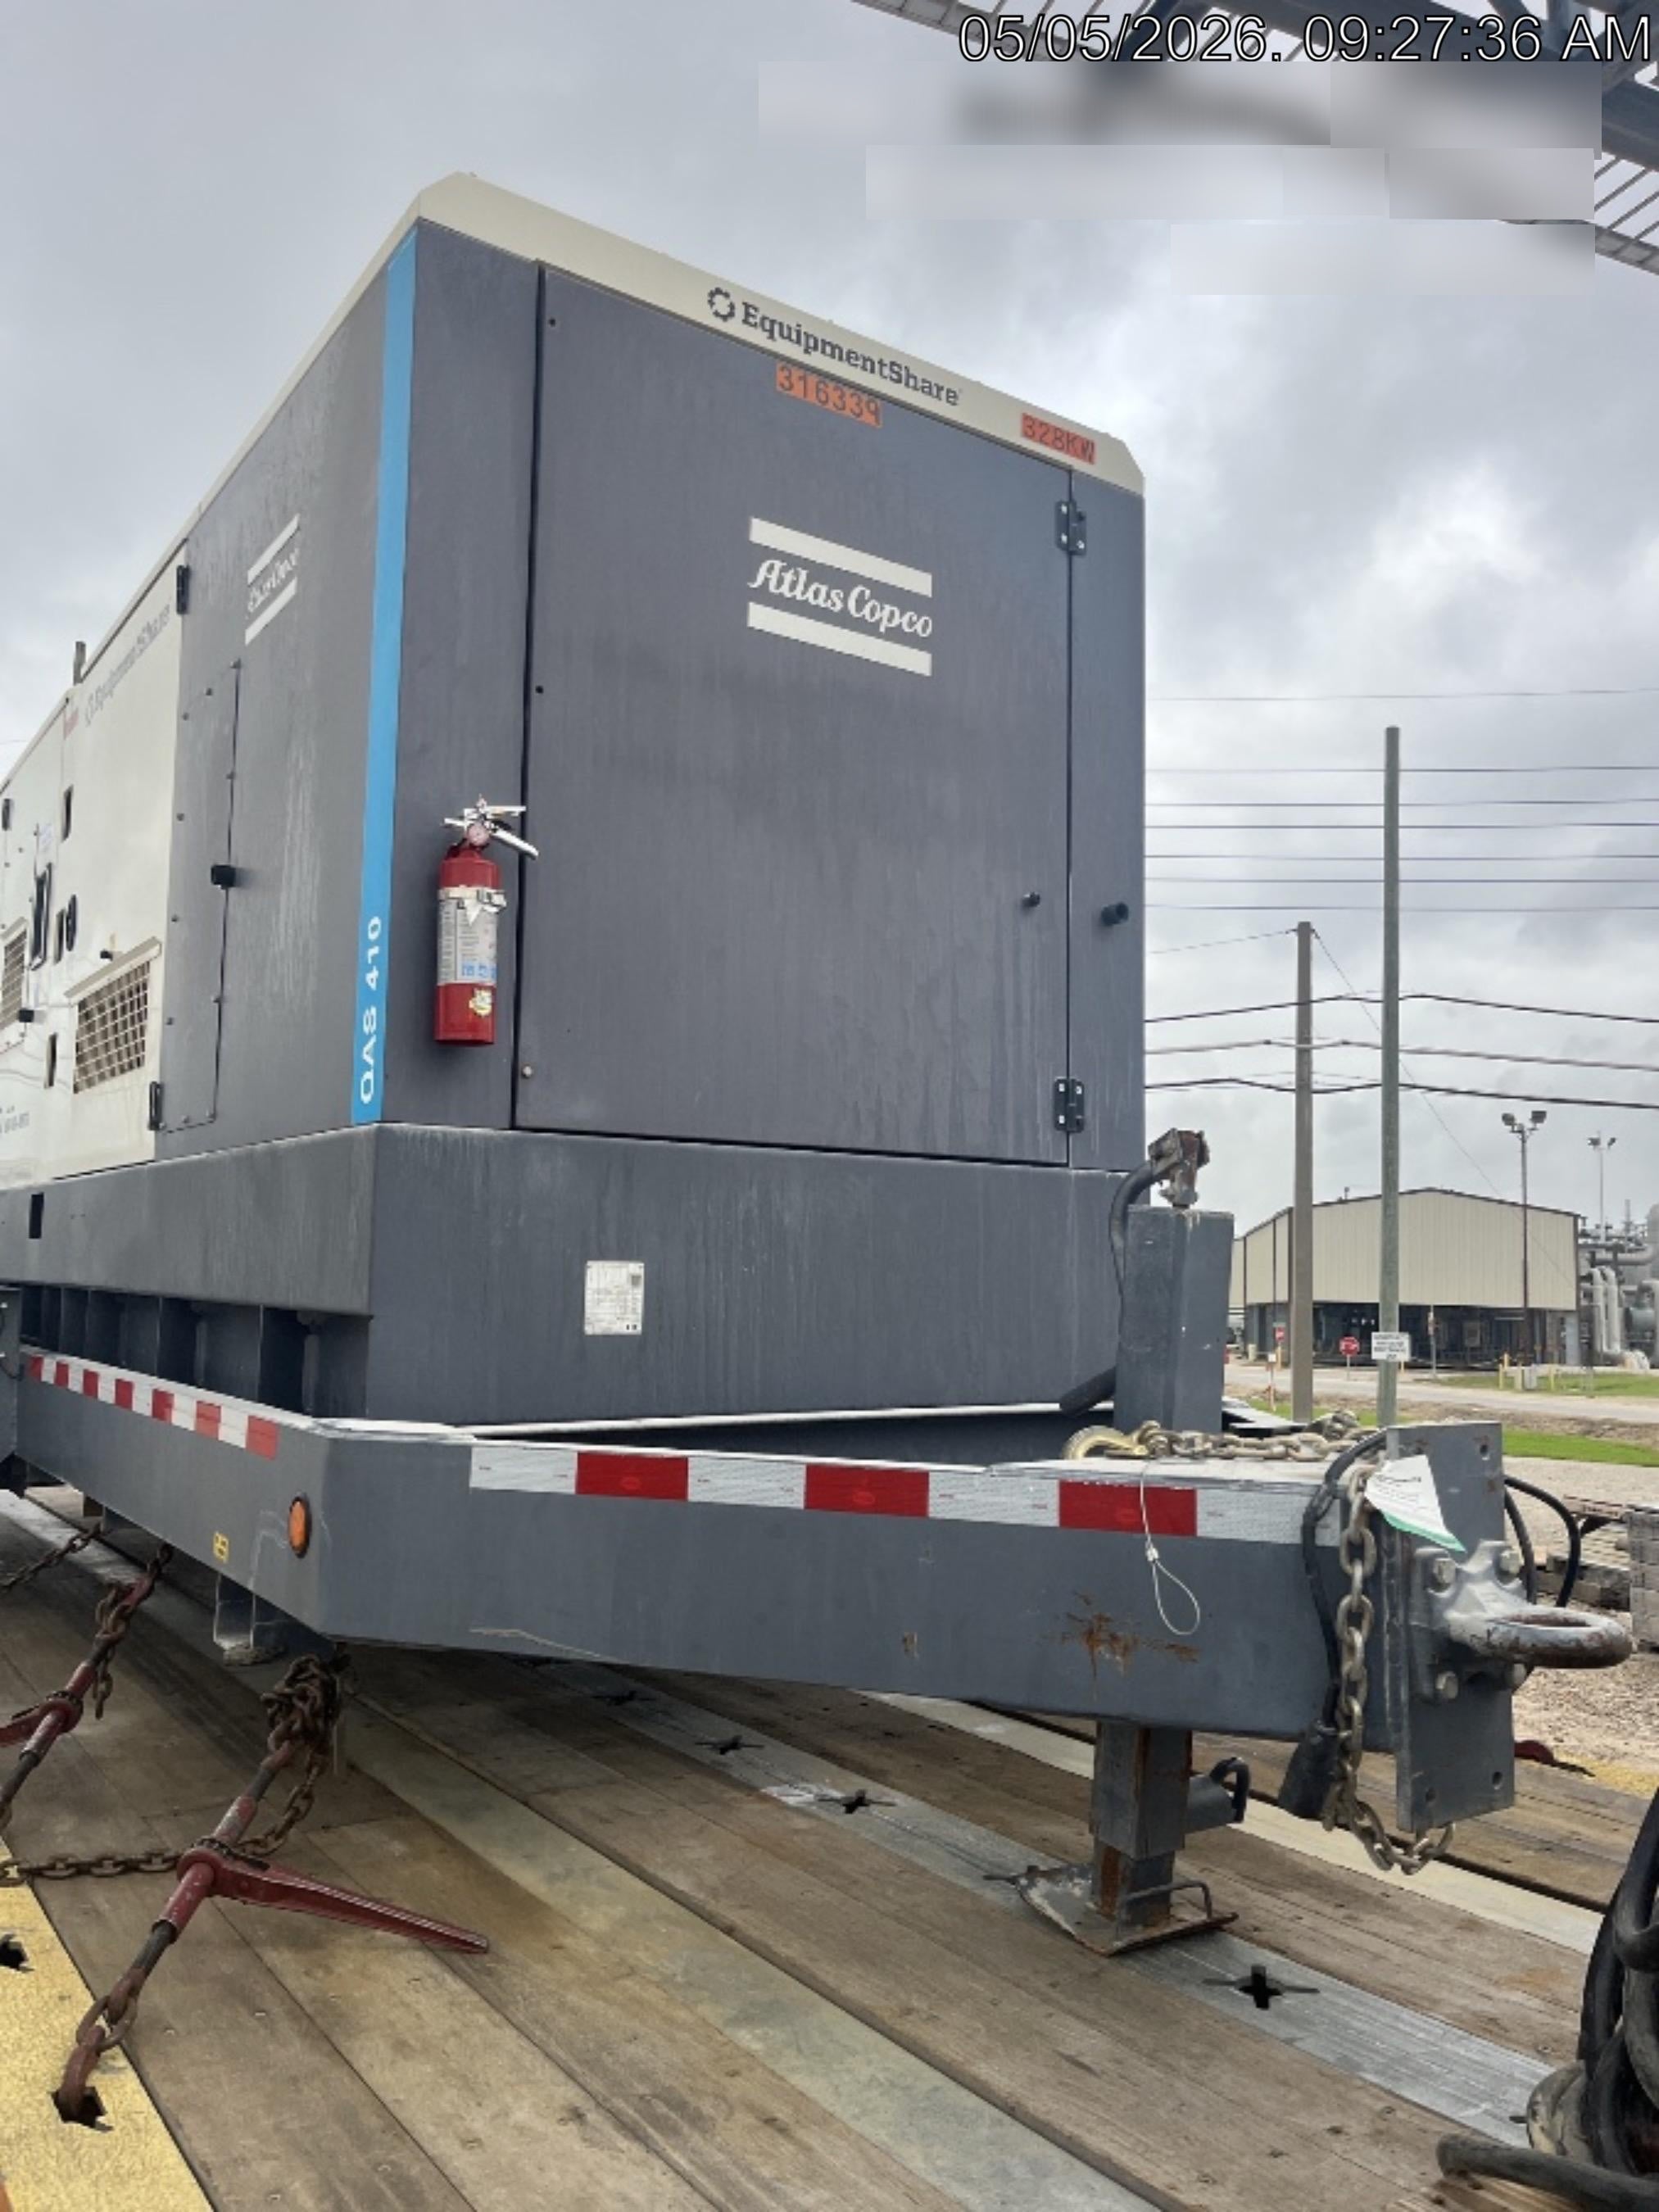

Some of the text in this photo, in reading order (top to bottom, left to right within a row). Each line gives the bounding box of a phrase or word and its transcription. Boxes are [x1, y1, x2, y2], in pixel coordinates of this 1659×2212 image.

[741, 301, 959, 406] EquipmentShare
[778, 365, 881, 425] 316339
[1023, 415, 1095, 465] 328KW
[747, 559, 932, 637] Atlas Copco
[360, 916, 382, 1104] QAS 410
